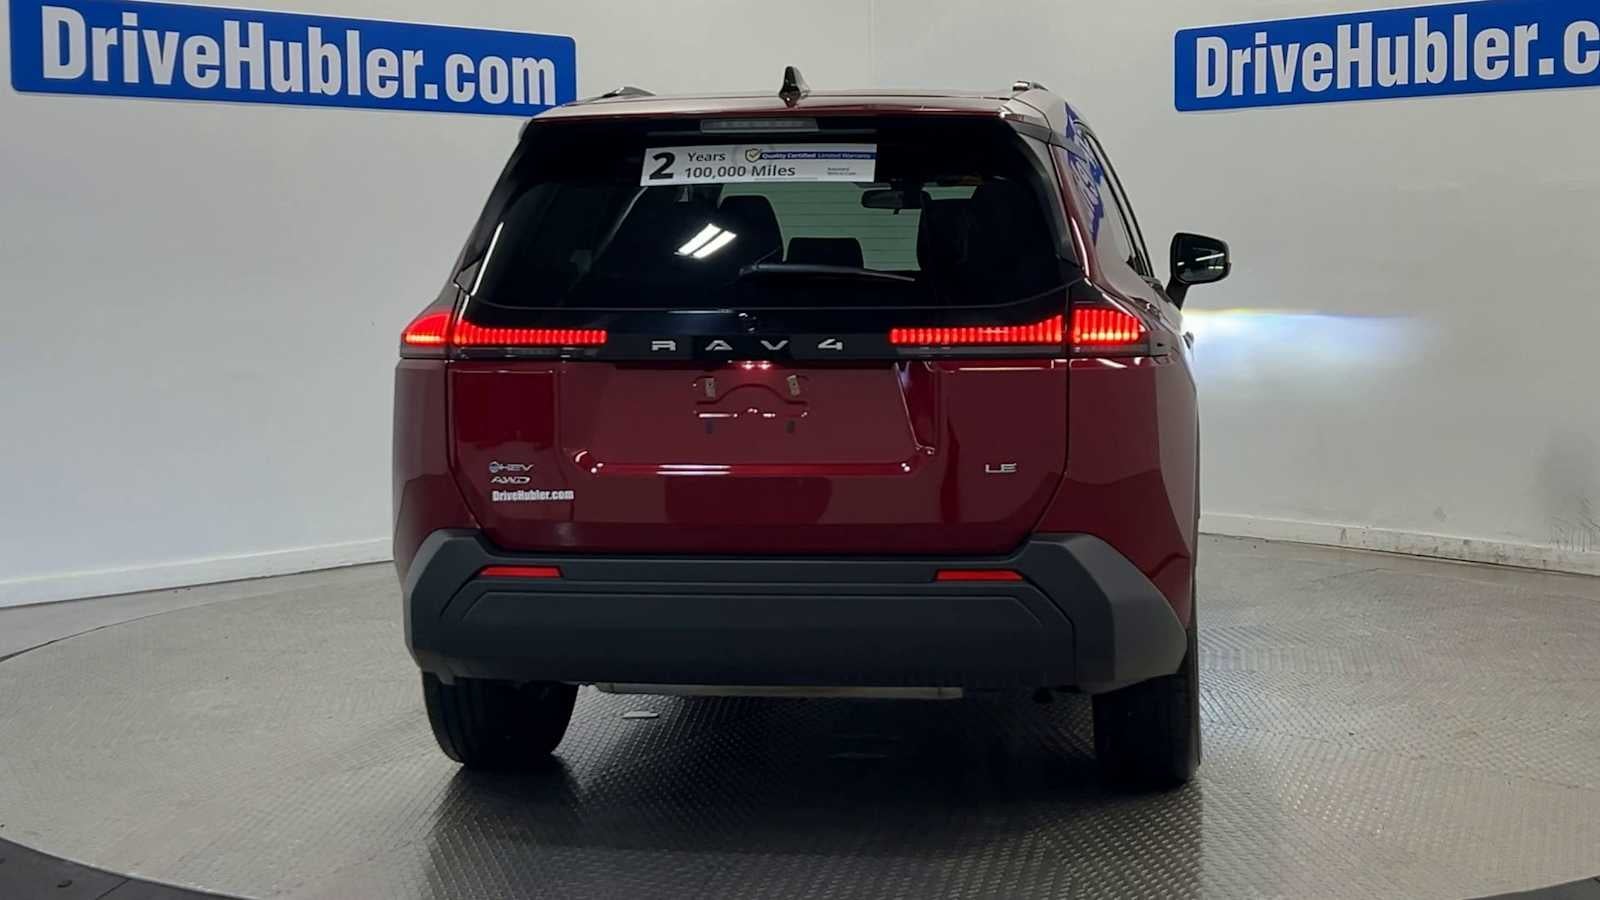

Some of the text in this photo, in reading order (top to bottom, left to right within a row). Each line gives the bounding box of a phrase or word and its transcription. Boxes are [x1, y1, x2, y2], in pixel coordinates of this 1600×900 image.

[41, 5, 556, 106] DriveHubler.com
[687, 152, 726, 162] Years
[761, 153, 787, 161] Quality
[649, 151, 675, 180] 2
[685, 165, 796, 179] 100,000 Miles
[985, 463, 1017, 473] LE
[490, 476, 531, 484] AWD
[492, 490, 574, 501] DriveHubler.com
